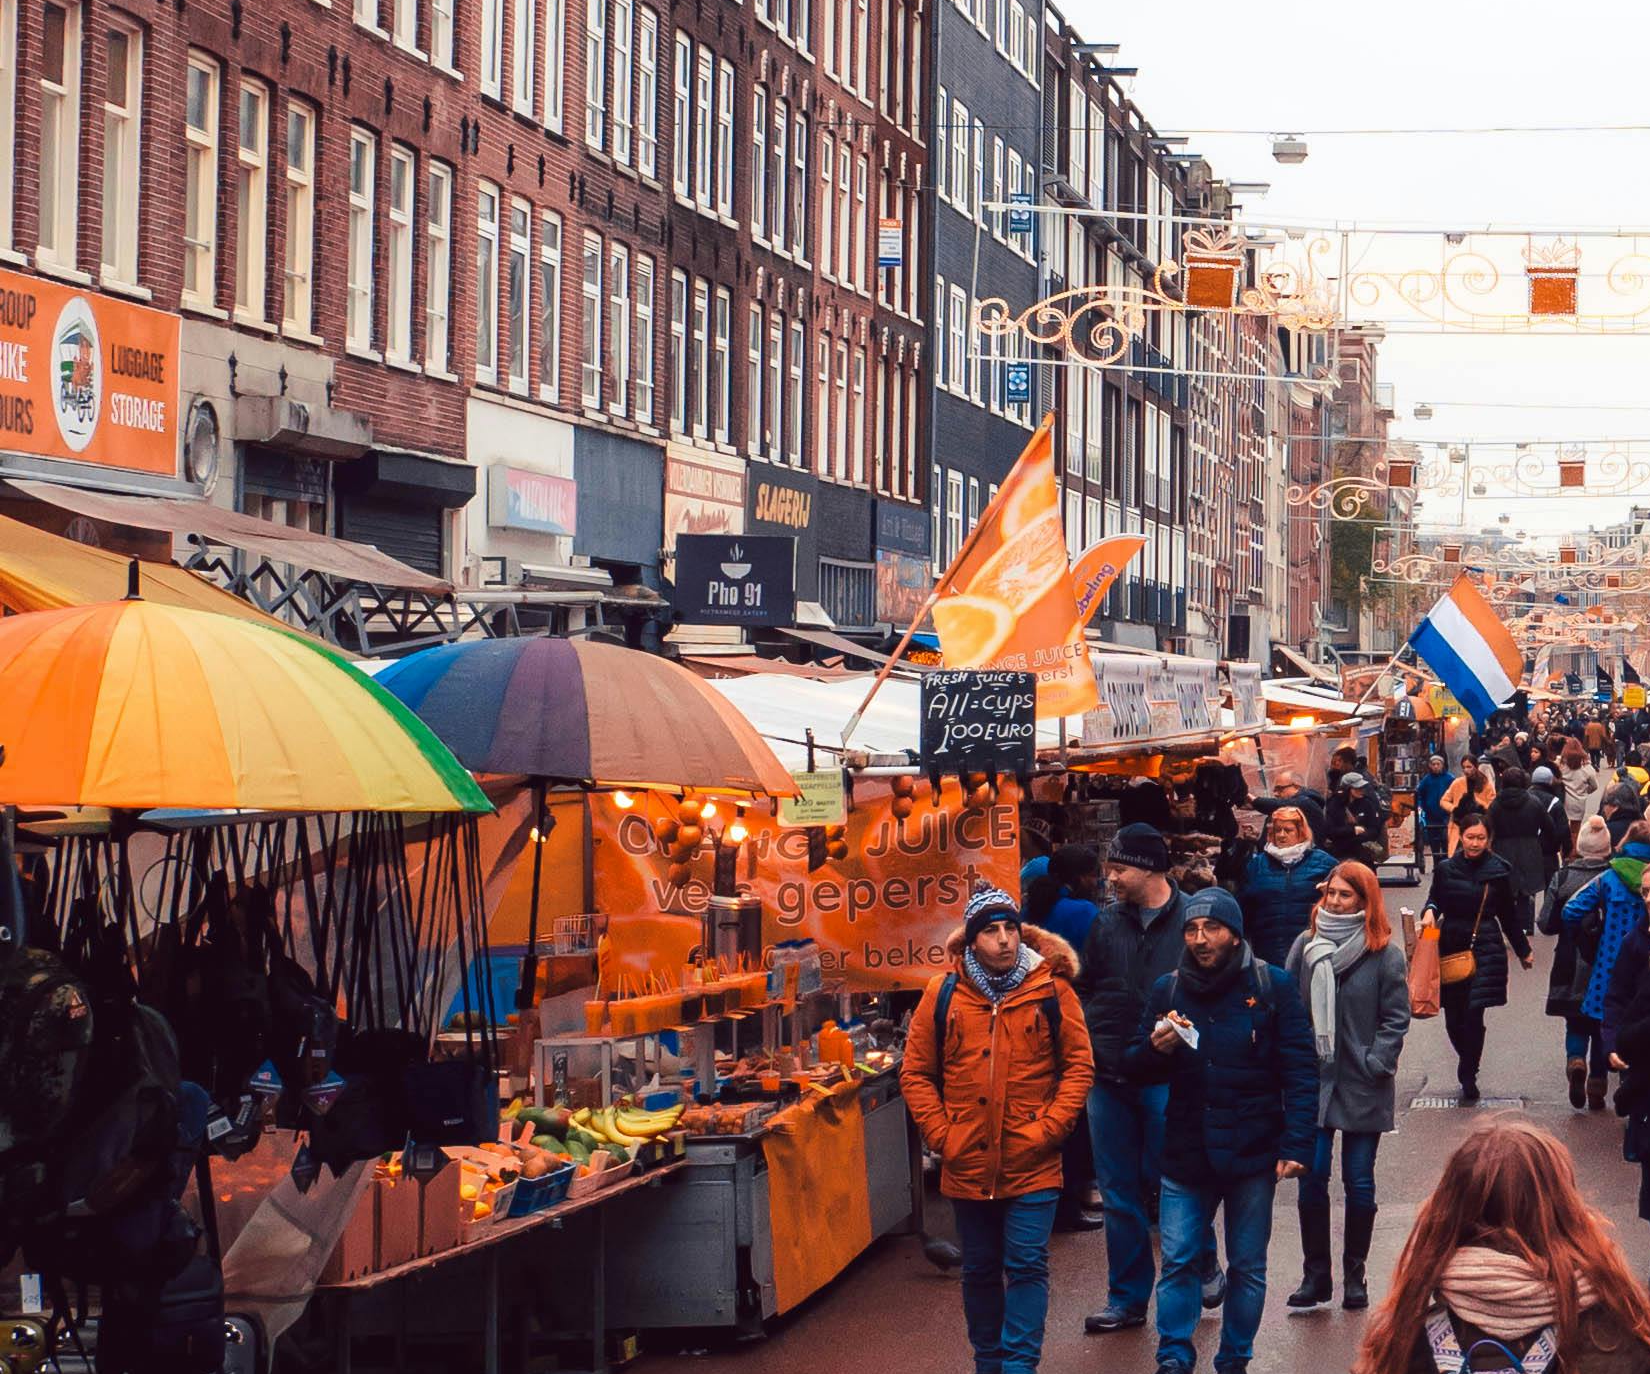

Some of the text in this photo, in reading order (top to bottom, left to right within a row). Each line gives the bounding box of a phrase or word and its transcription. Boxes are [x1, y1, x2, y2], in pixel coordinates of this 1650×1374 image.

[111, 343, 165, 384] LUGGAGE
[111, 392, 166, 433] STORAGE
[755, 481, 812, 530] SLAGERIJ
[707, 580, 762, 607] Pho 91
[1032, 641, 1083, 668] JUICE
[926, 672, 967, 690] FRESH
[984, 722, 1034, 741] EURO
[866, 803, 1018, 859] JUICE
[776, 864, 981, 926] geperst
[863, 937, 956, 969] beke
